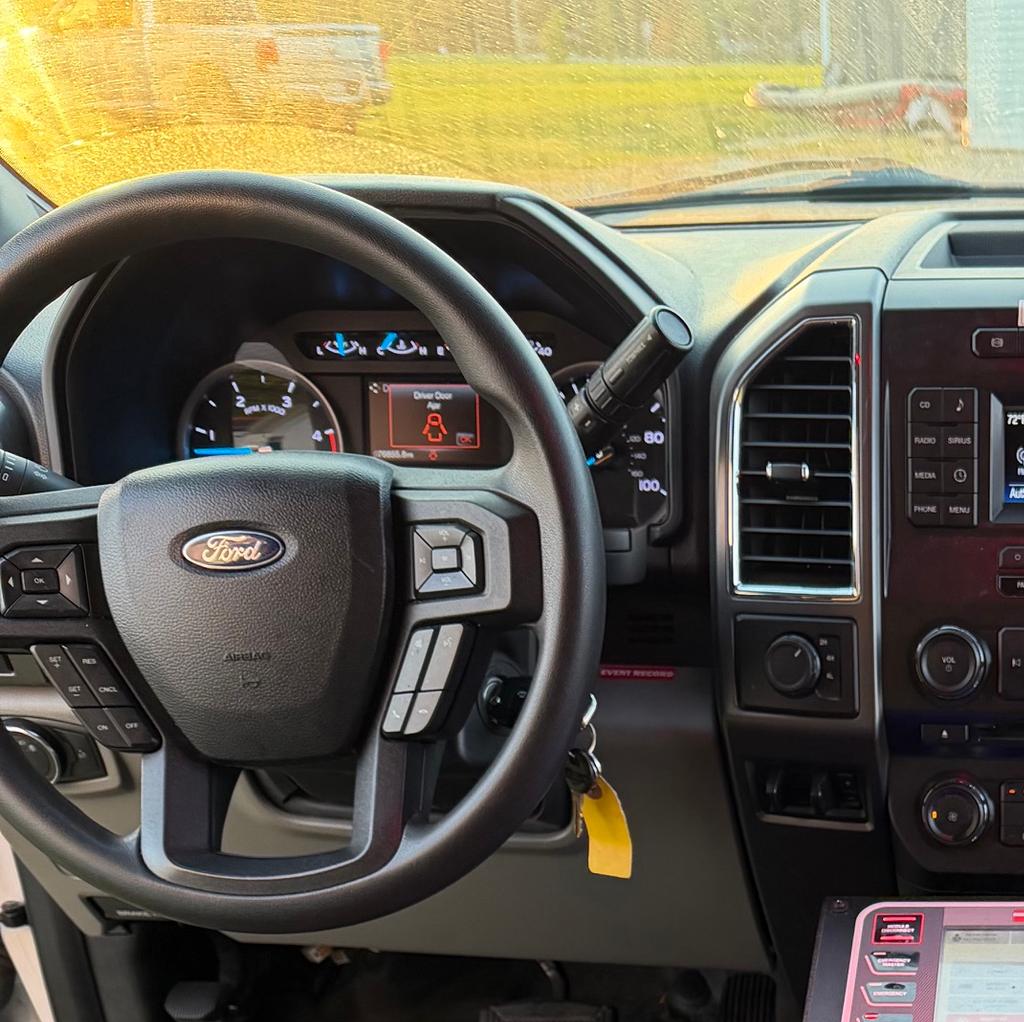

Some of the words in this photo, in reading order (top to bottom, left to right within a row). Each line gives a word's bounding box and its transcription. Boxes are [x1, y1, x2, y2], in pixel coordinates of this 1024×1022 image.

[235, 395, 246, 408] 2
[281, 395, 292, 408] 3
[919, 401, 930, 409] CD
[312, 430, 323, 442] 4
[644, 431, 664, 444] 80
[947, 437, 972, 445] SIRIUS
[639, 480, 660, 492] 100
[949, 506, 970, 514] MENU
[202, 536, 261, 563] Ford
[942, 656, 956, 664] VOL
